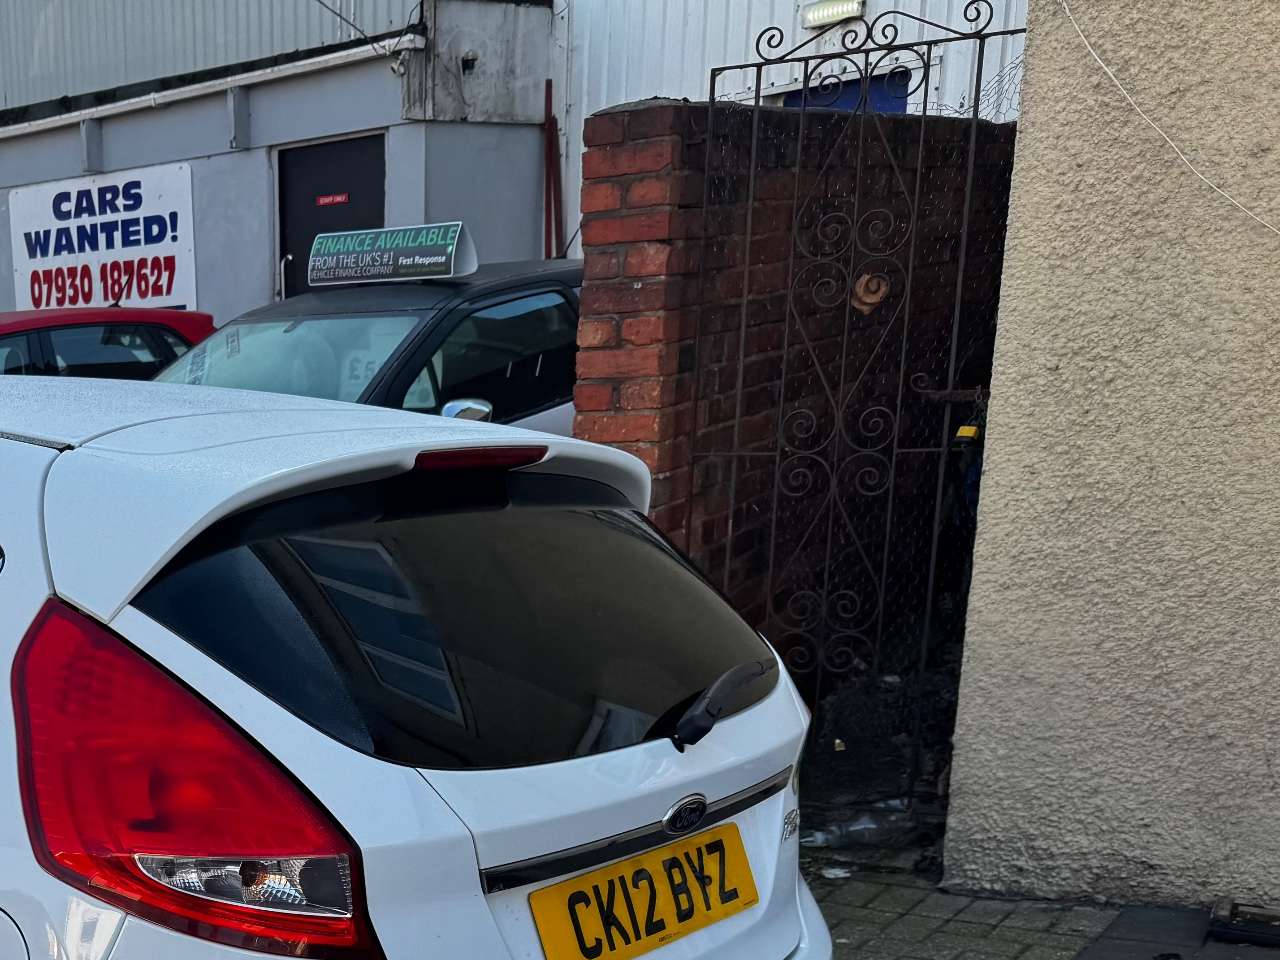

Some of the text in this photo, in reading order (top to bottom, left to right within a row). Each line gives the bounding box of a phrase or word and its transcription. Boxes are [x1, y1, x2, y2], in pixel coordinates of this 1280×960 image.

[52, 180, 143, 221] CARS
[23, 211, 178, 260] WANTED!
[314, 226, 458, 255] FINANCE AVAILABLE
[311, 251, 394, 270] FROM THE UK'S #1
[398, 255, 446, 266] First Response
[30, 255, 176, 310] 07930 187627
[567, 838, 740, 960] CK12 BYZ
